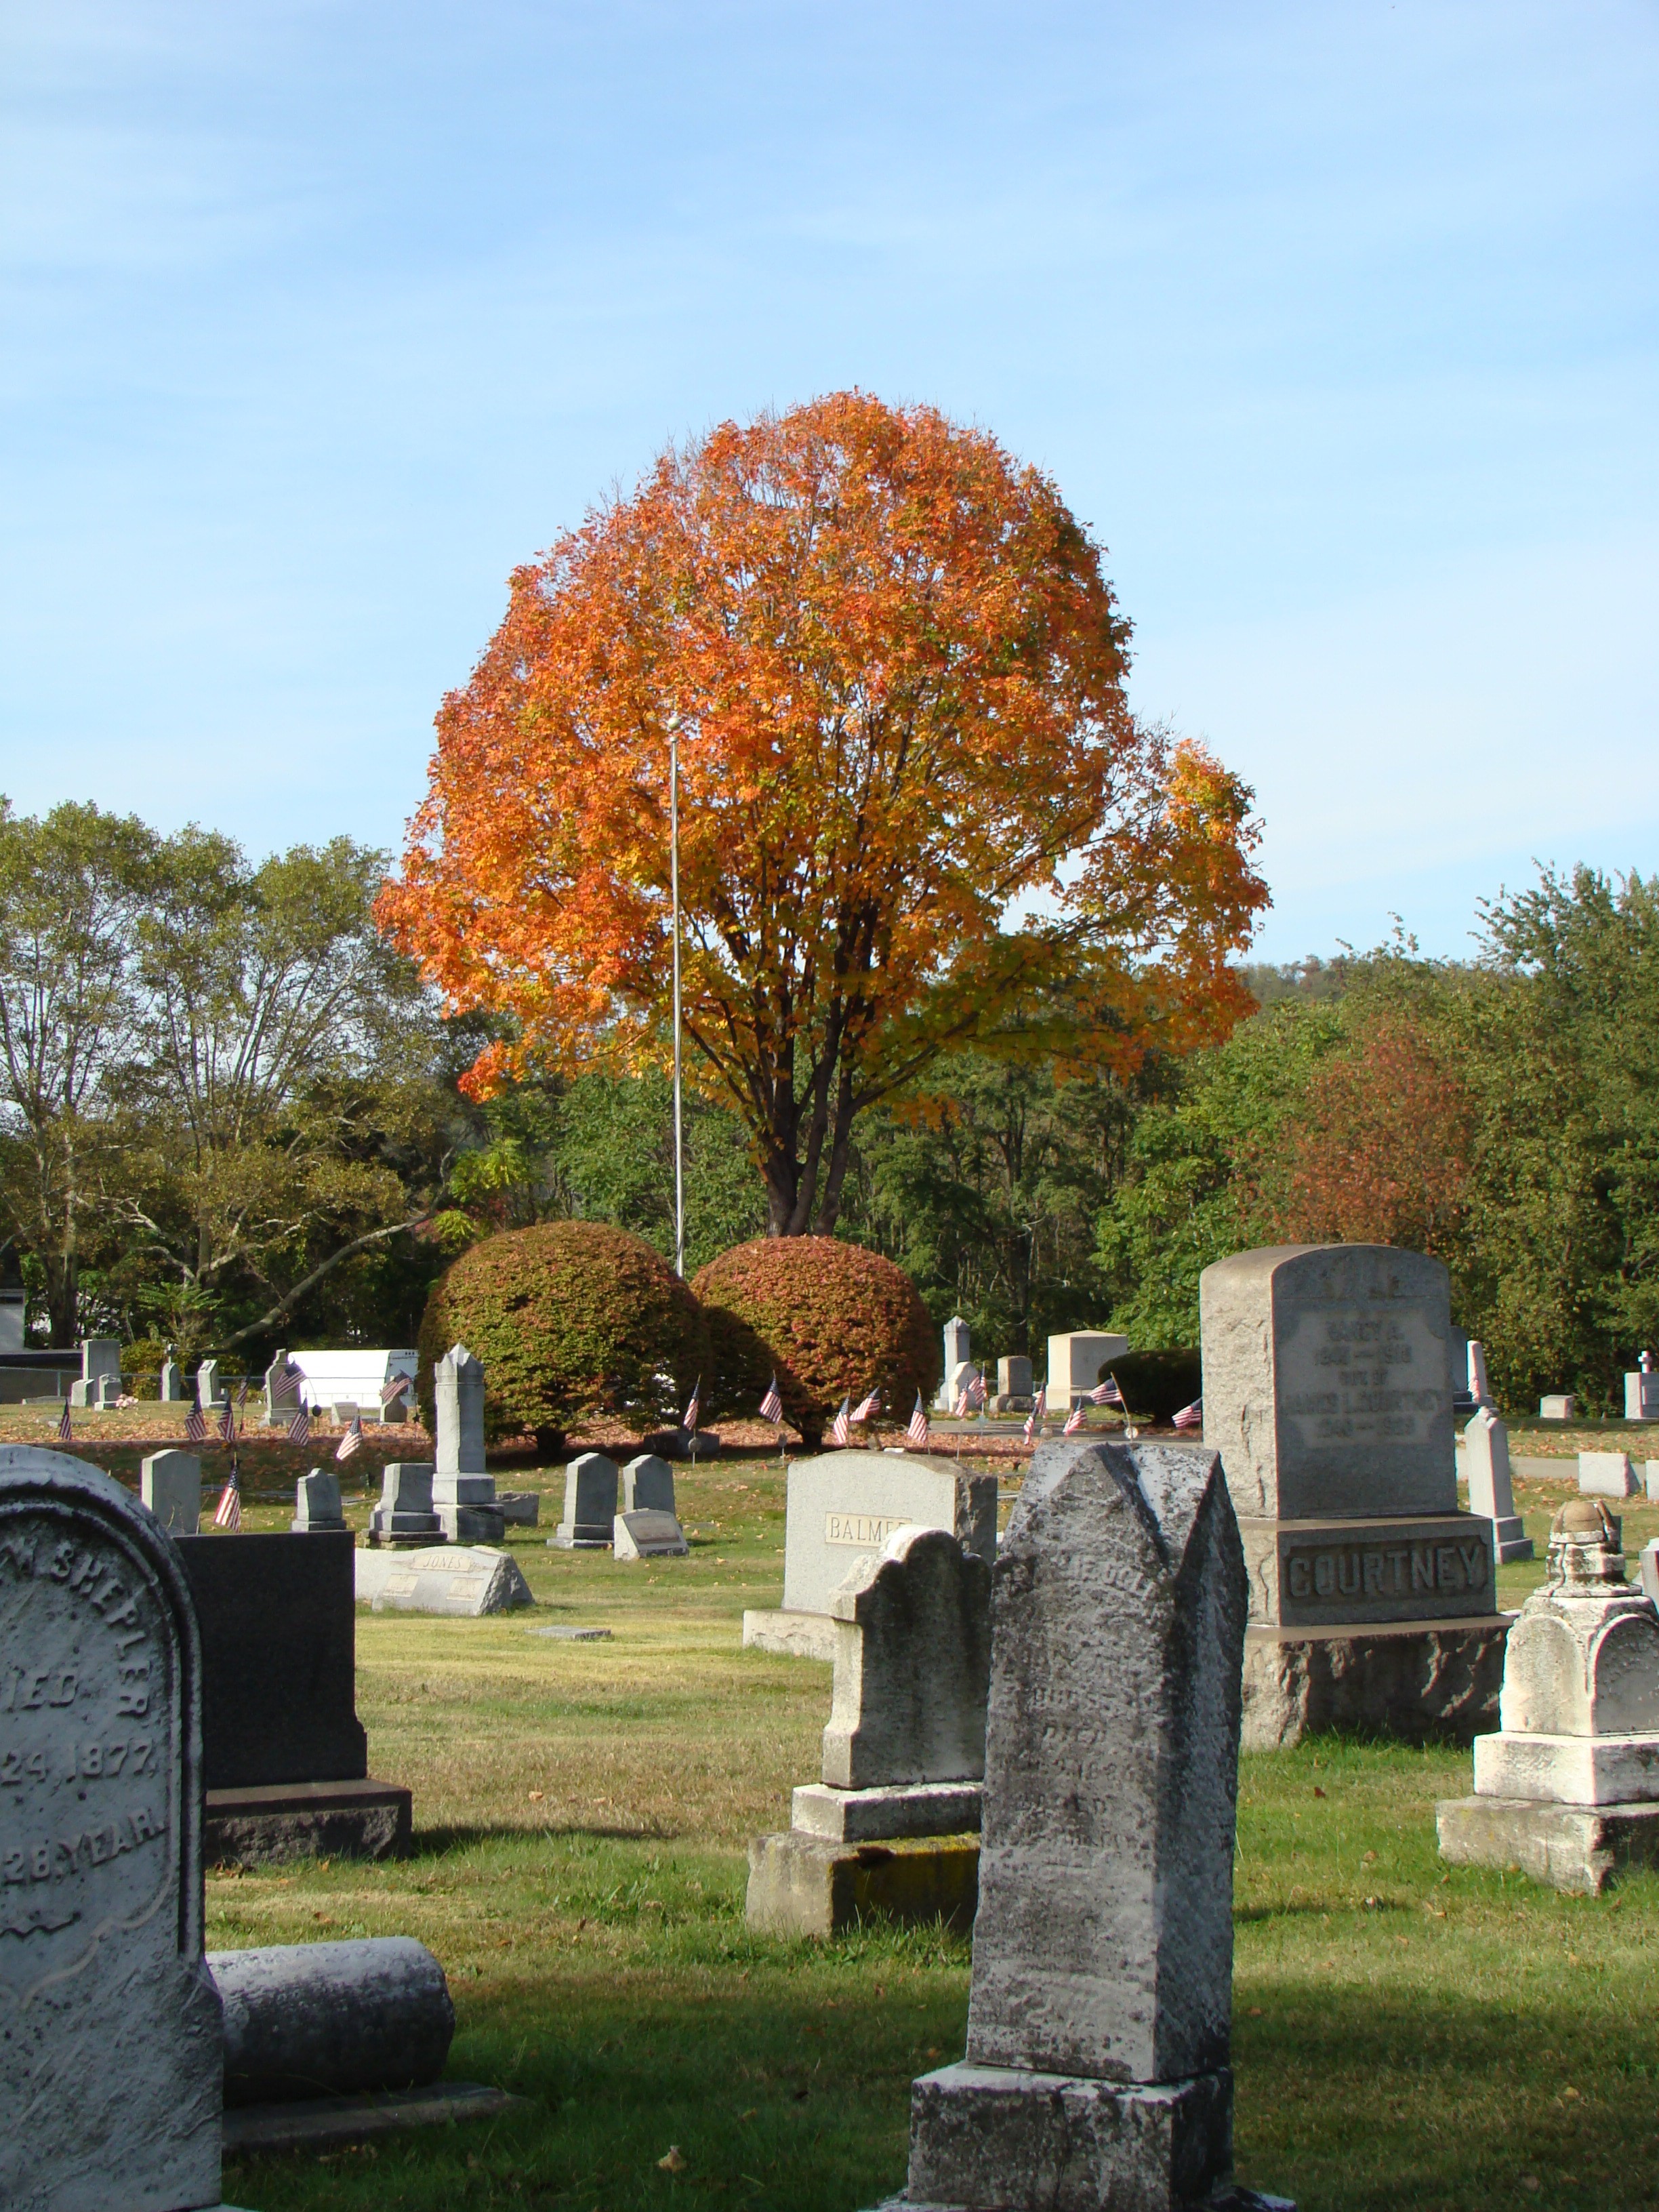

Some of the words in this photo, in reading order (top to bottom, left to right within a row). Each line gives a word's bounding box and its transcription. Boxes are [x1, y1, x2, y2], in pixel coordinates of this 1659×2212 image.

[830, 1516, 906, 1542] BALME
[423, 1555, 463, 1570] JONES
[1289, 1544, 1482, 1598] COURTNEY
[49, 1538, 151, 1717] SHEPLER
[0, 1666, 81, 1712] IED
